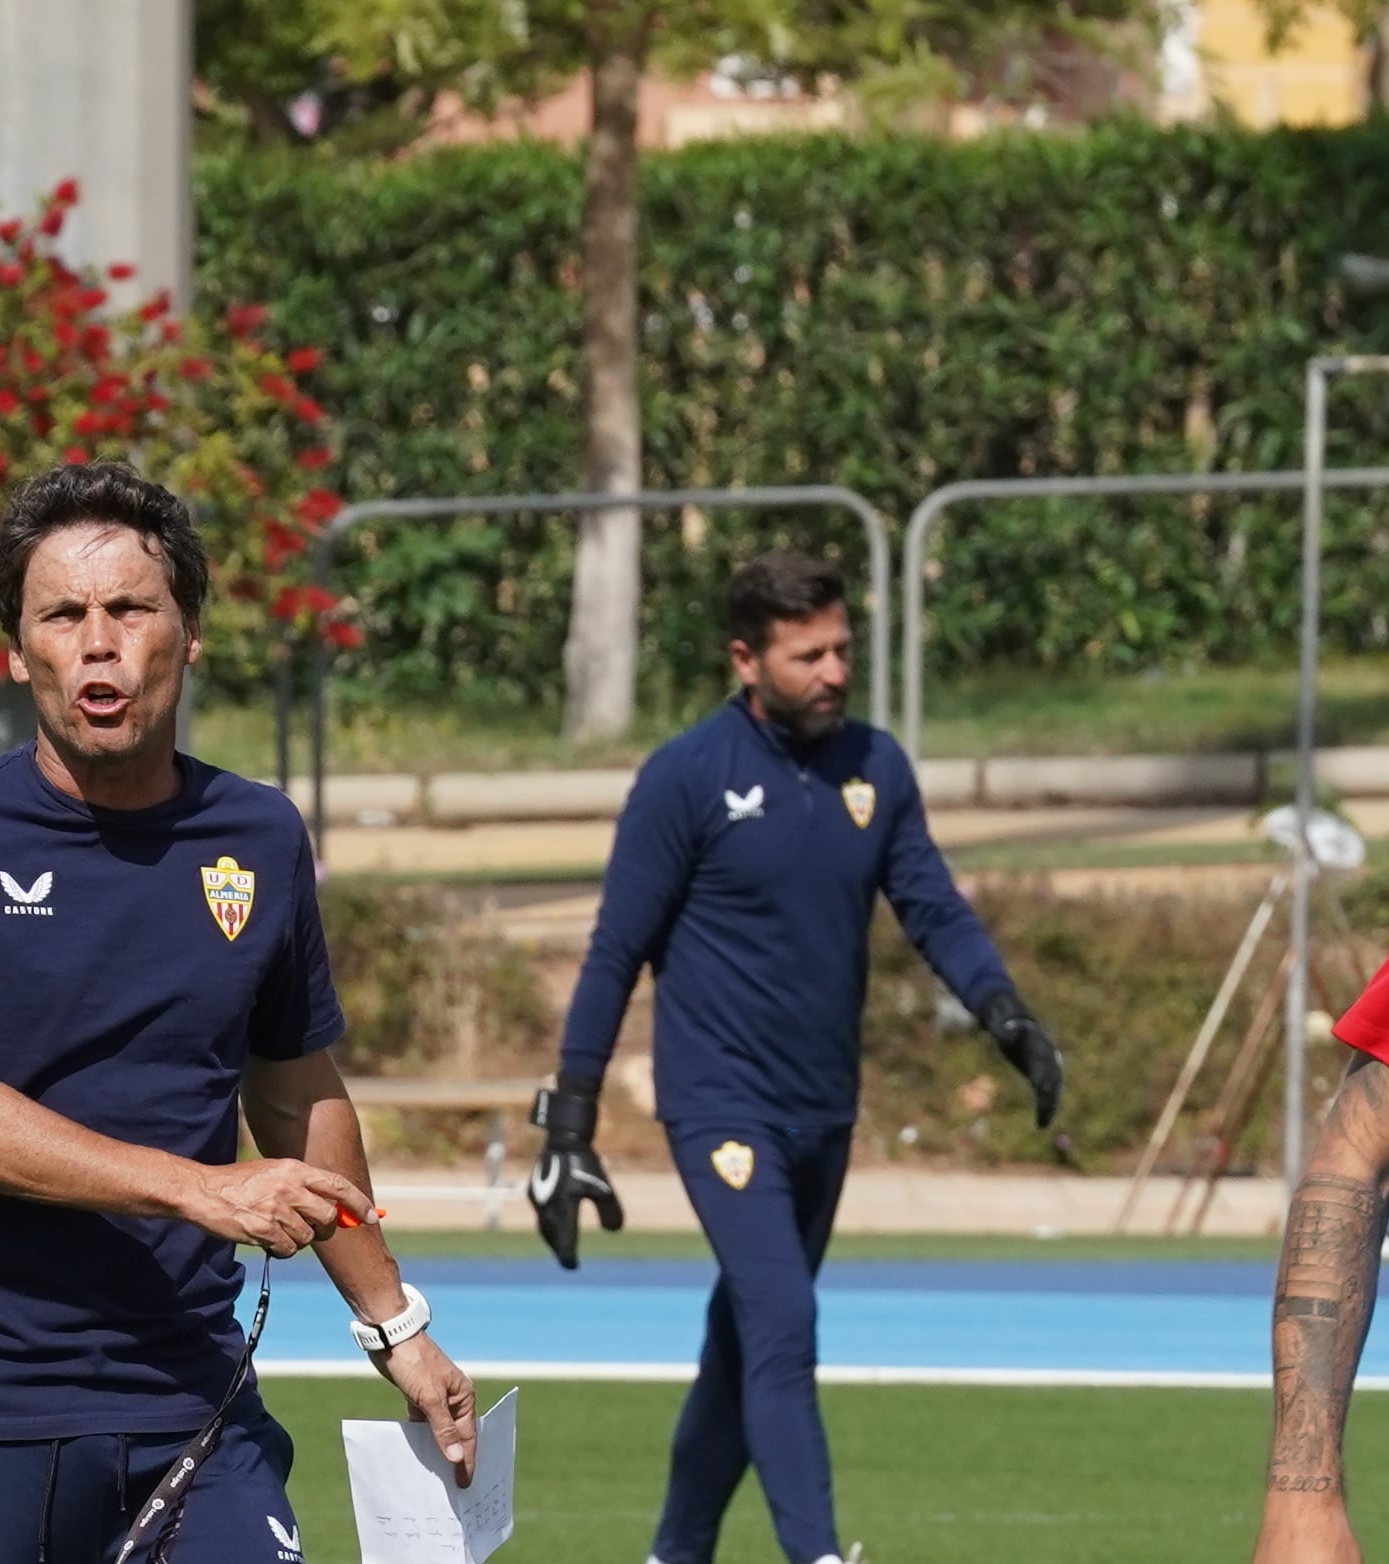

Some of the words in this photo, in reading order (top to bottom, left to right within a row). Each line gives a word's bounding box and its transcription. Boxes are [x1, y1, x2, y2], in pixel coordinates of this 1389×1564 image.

[209, 872, 219, 884] U
[237, 875, 248, 886] D
[4, 905, 54, 916] CASTORE
